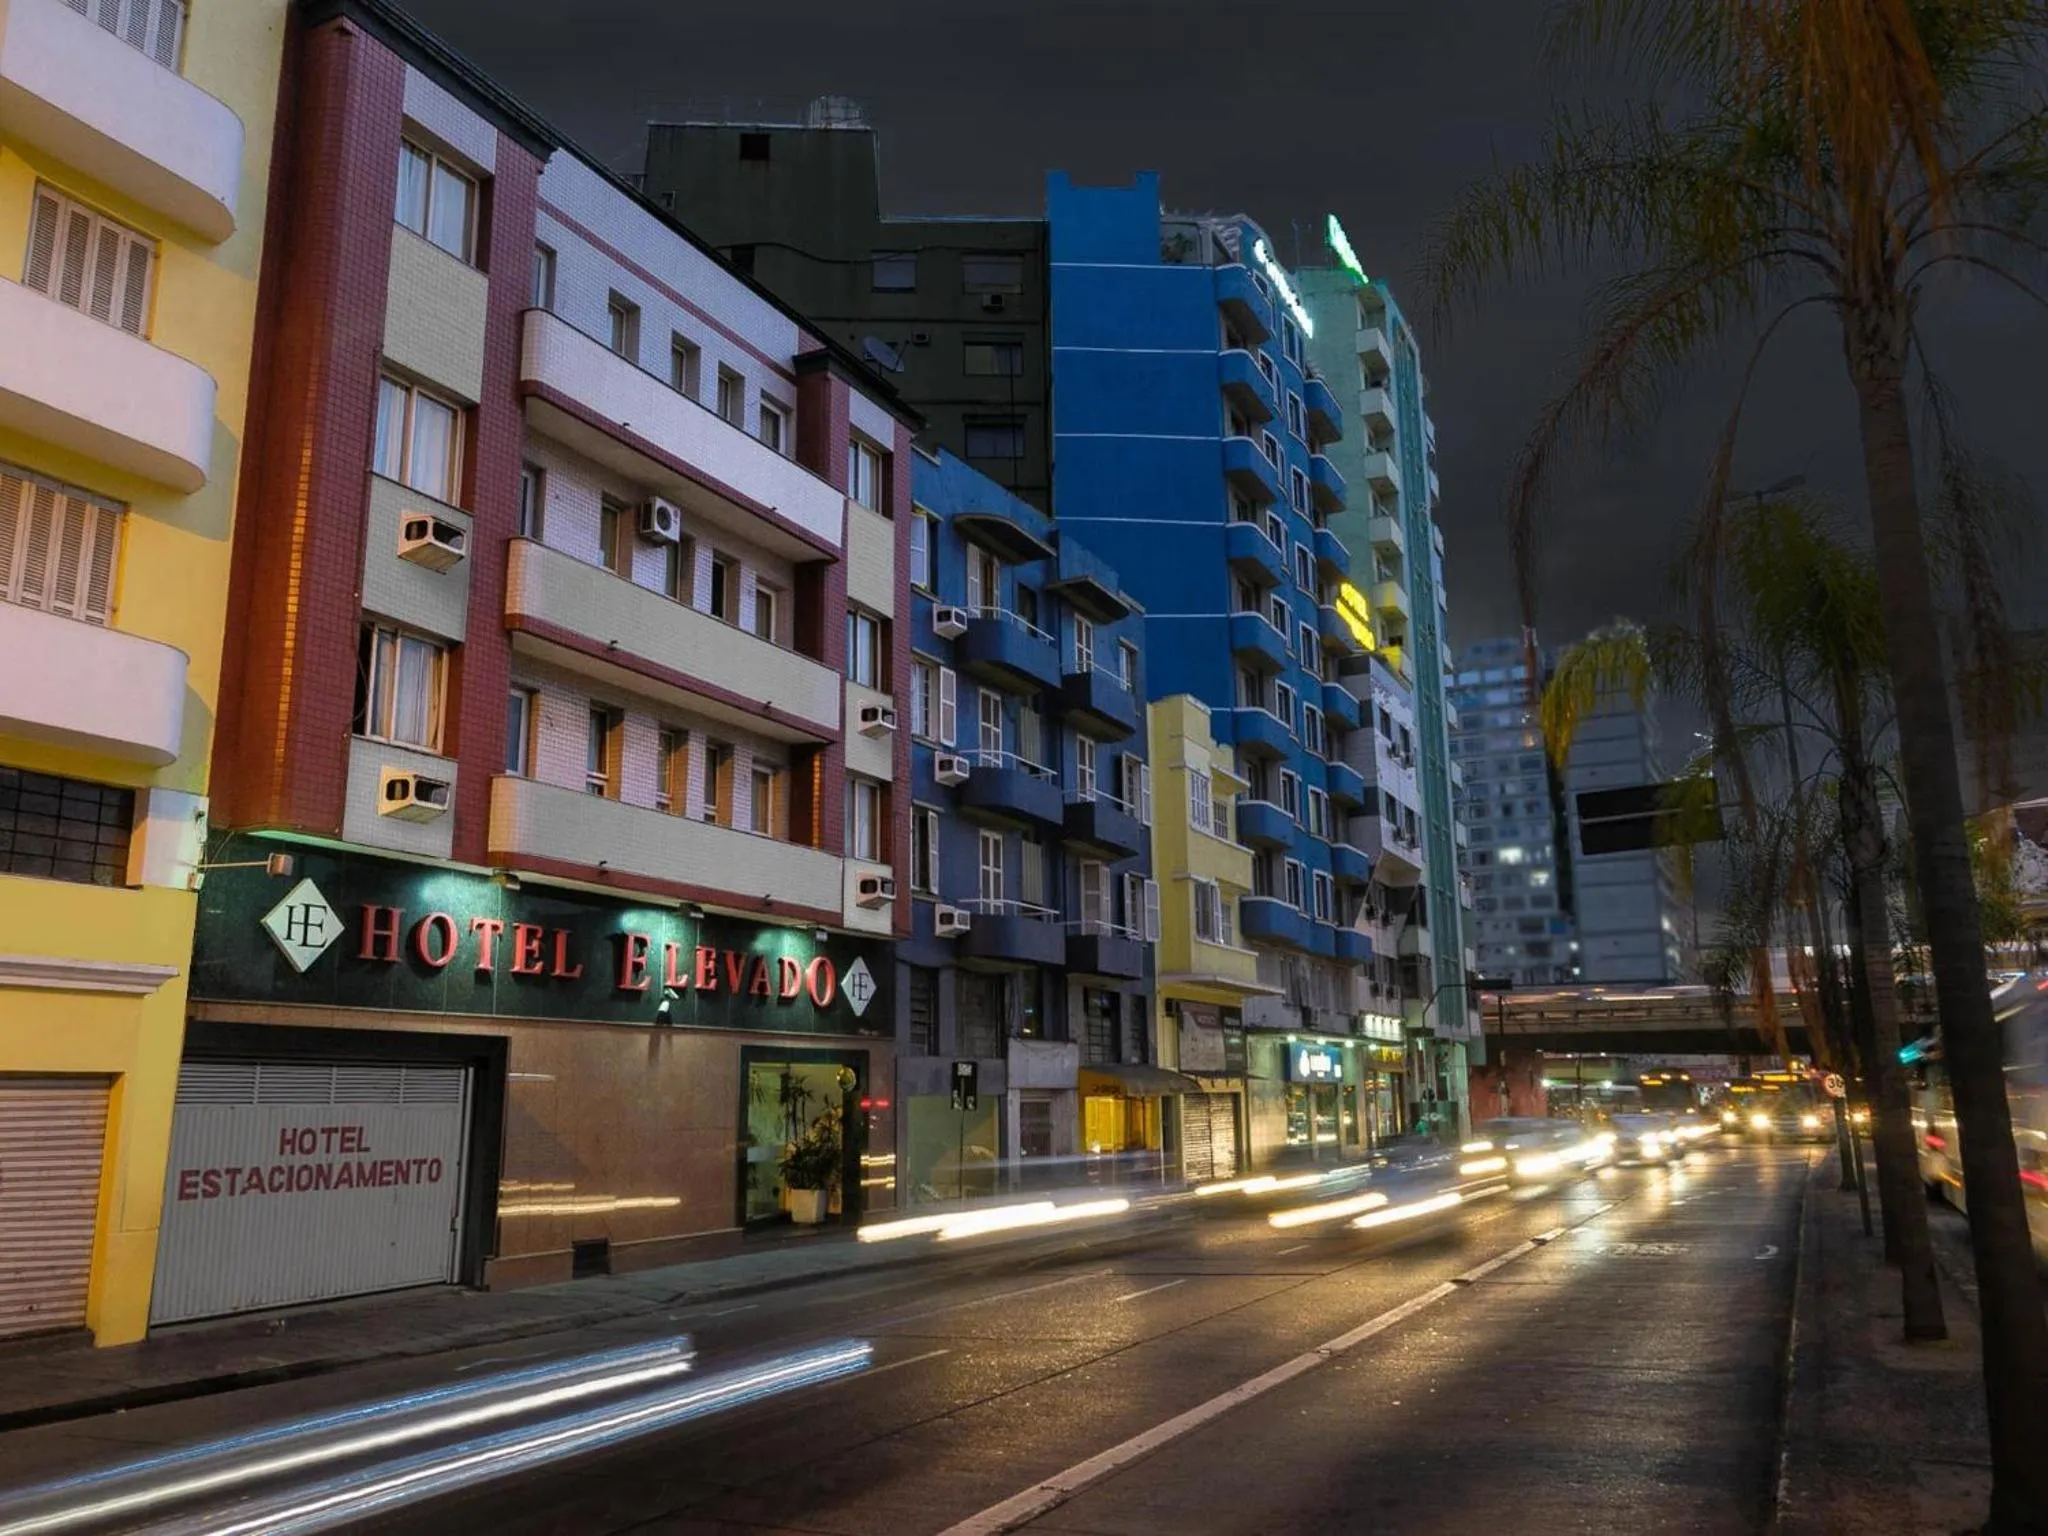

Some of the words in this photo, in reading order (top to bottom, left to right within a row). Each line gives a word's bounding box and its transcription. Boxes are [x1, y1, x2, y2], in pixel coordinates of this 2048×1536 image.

[358, 903, 585, 979] HOTEL
[617, 932, 837, 1008] ELEVADO
[278, 1126, 371, 1157] HOTEL
[177, 1158, 443, 1201] ESTACIONAMENTO
